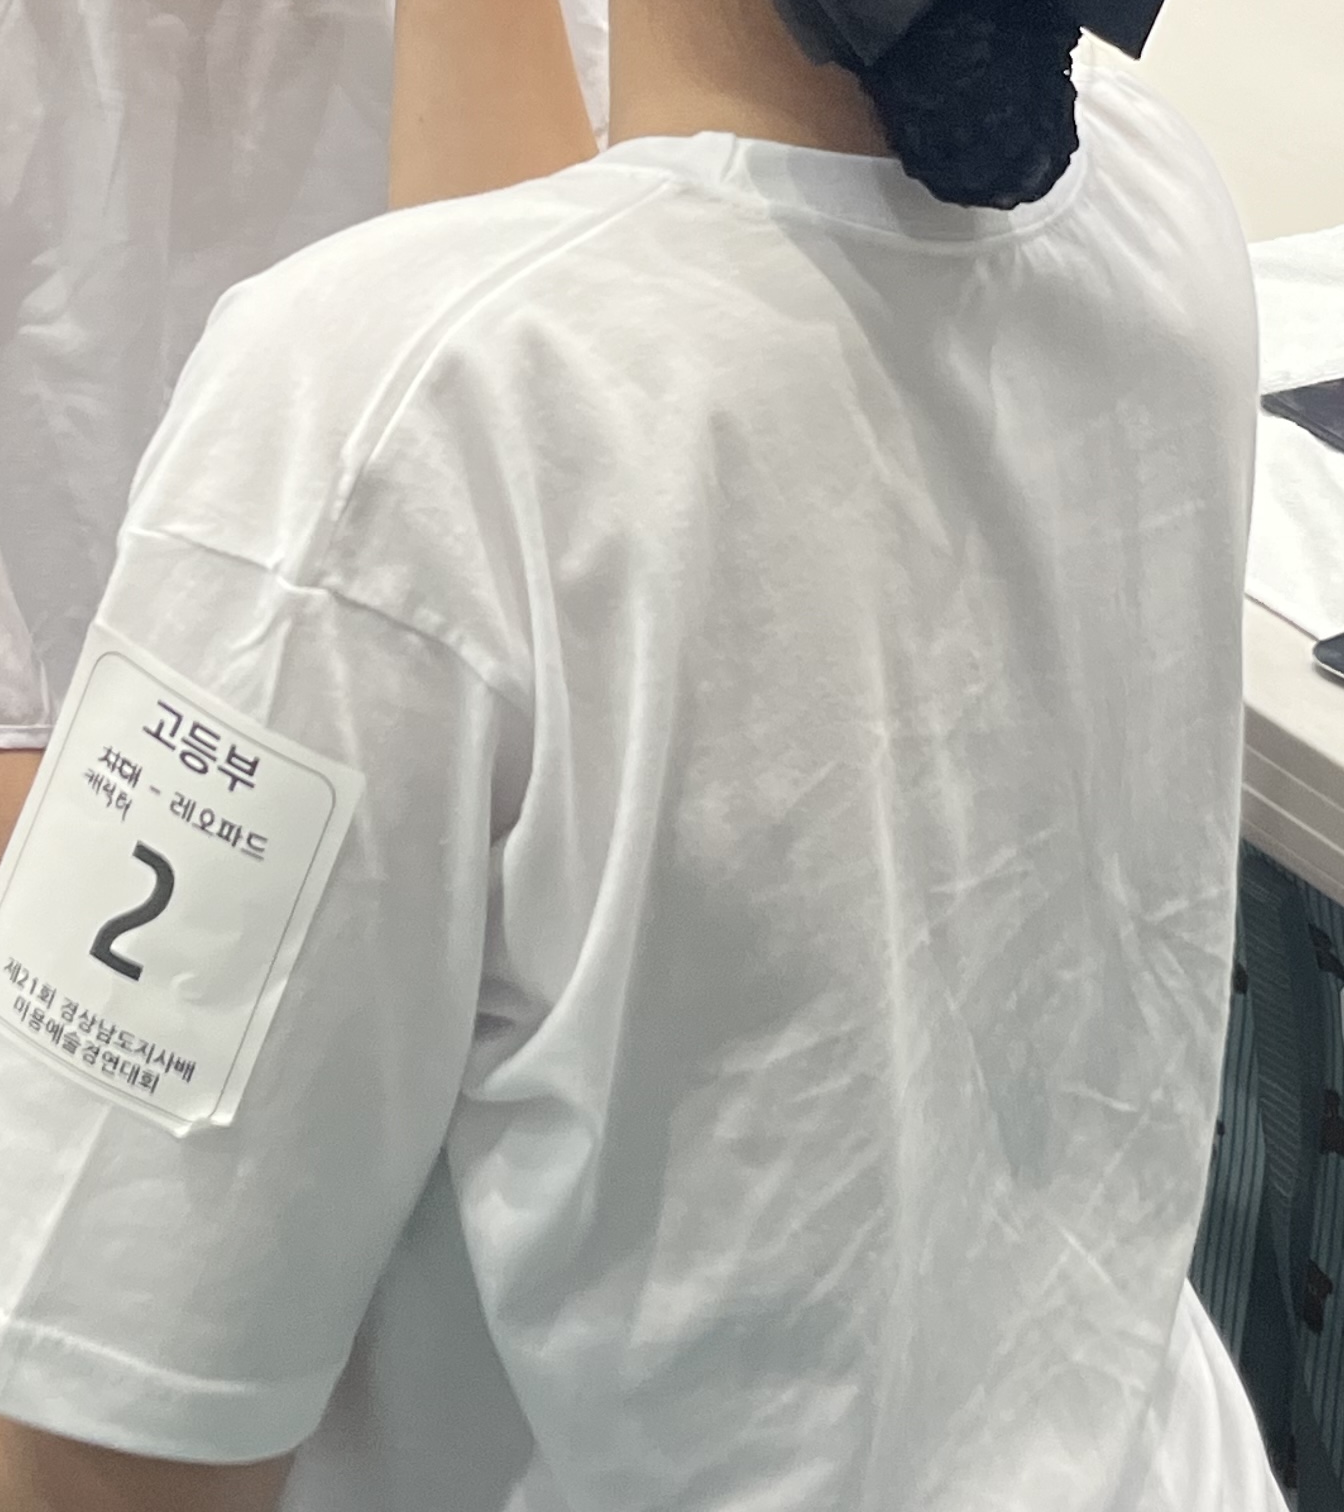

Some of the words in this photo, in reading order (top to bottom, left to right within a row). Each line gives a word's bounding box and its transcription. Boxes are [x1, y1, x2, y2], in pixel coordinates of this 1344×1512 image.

[142, 699, 262, 792] 고등부
[169, 791, 269, 862] 레오파드
[88, 839, 176, 982] 2
[3, 956, 58, 1010] 제21회
[60, 996, 197, 1084] 경상남도지사배
[12, 995, 161, 1095] 미용예술경연대회
